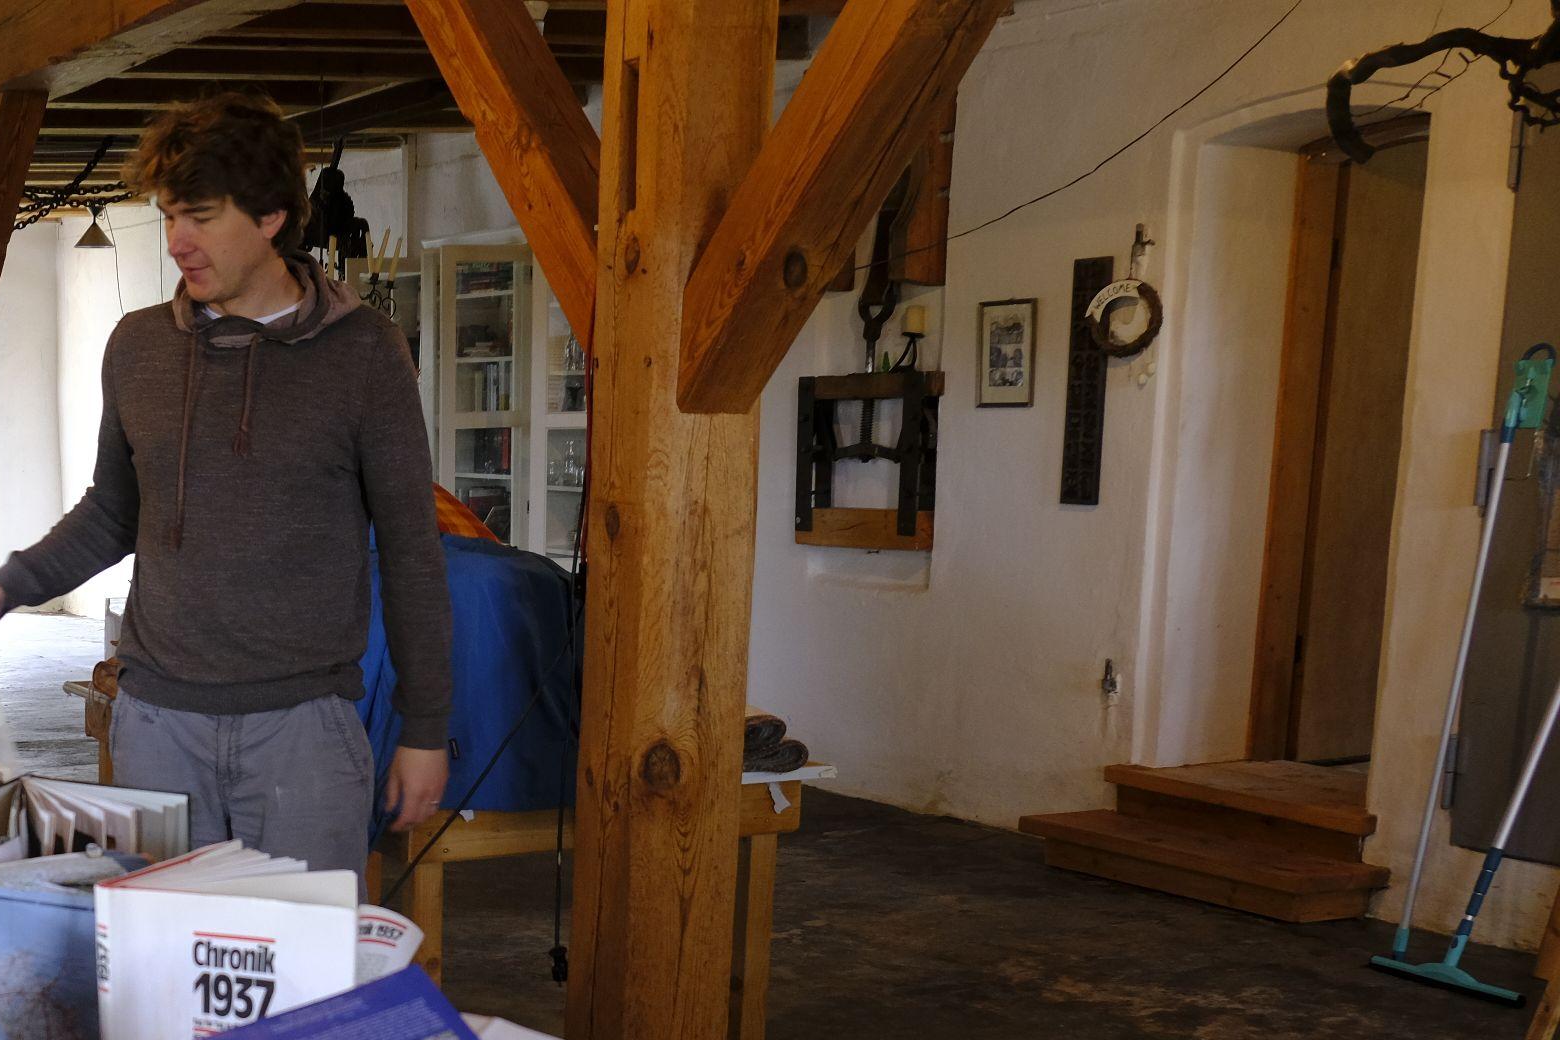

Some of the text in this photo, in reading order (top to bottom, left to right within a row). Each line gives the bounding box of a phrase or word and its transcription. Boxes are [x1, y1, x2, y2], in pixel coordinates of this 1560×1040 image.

[1092, 283, 1131, 310] WELCOME
[193, 940, 277, 974] Chronik
[193, 972, 277, 1019] 1937
